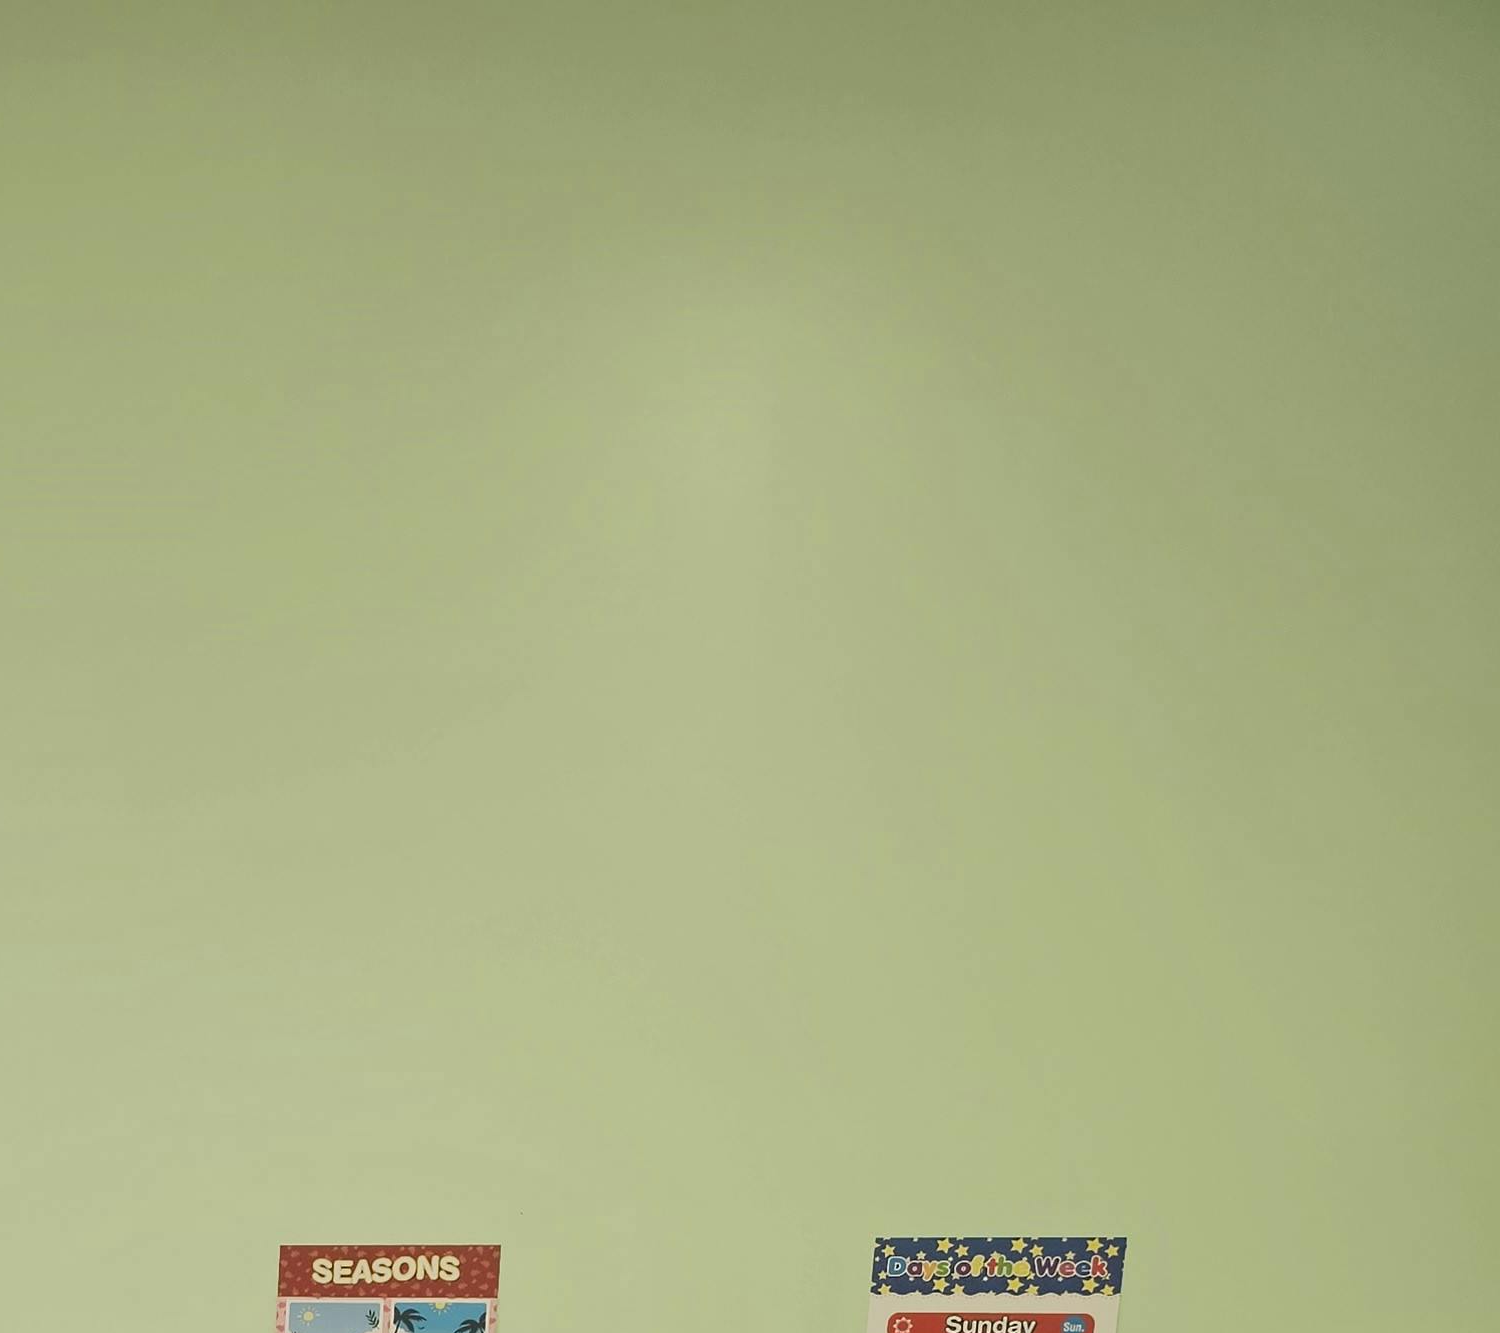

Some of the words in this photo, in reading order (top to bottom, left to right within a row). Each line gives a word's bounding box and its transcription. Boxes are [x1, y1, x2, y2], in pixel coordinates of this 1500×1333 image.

[312, 1255, 461, 1285] SEASONS
[886, 1256, 951, 1281] Days
[954, 1254, 986, 1277] of
[986, 1255, 1032, 1278] the
[1034, 1255, 1108, 1278] Week
[1062, 1321, 1085, 1333] Sun.
